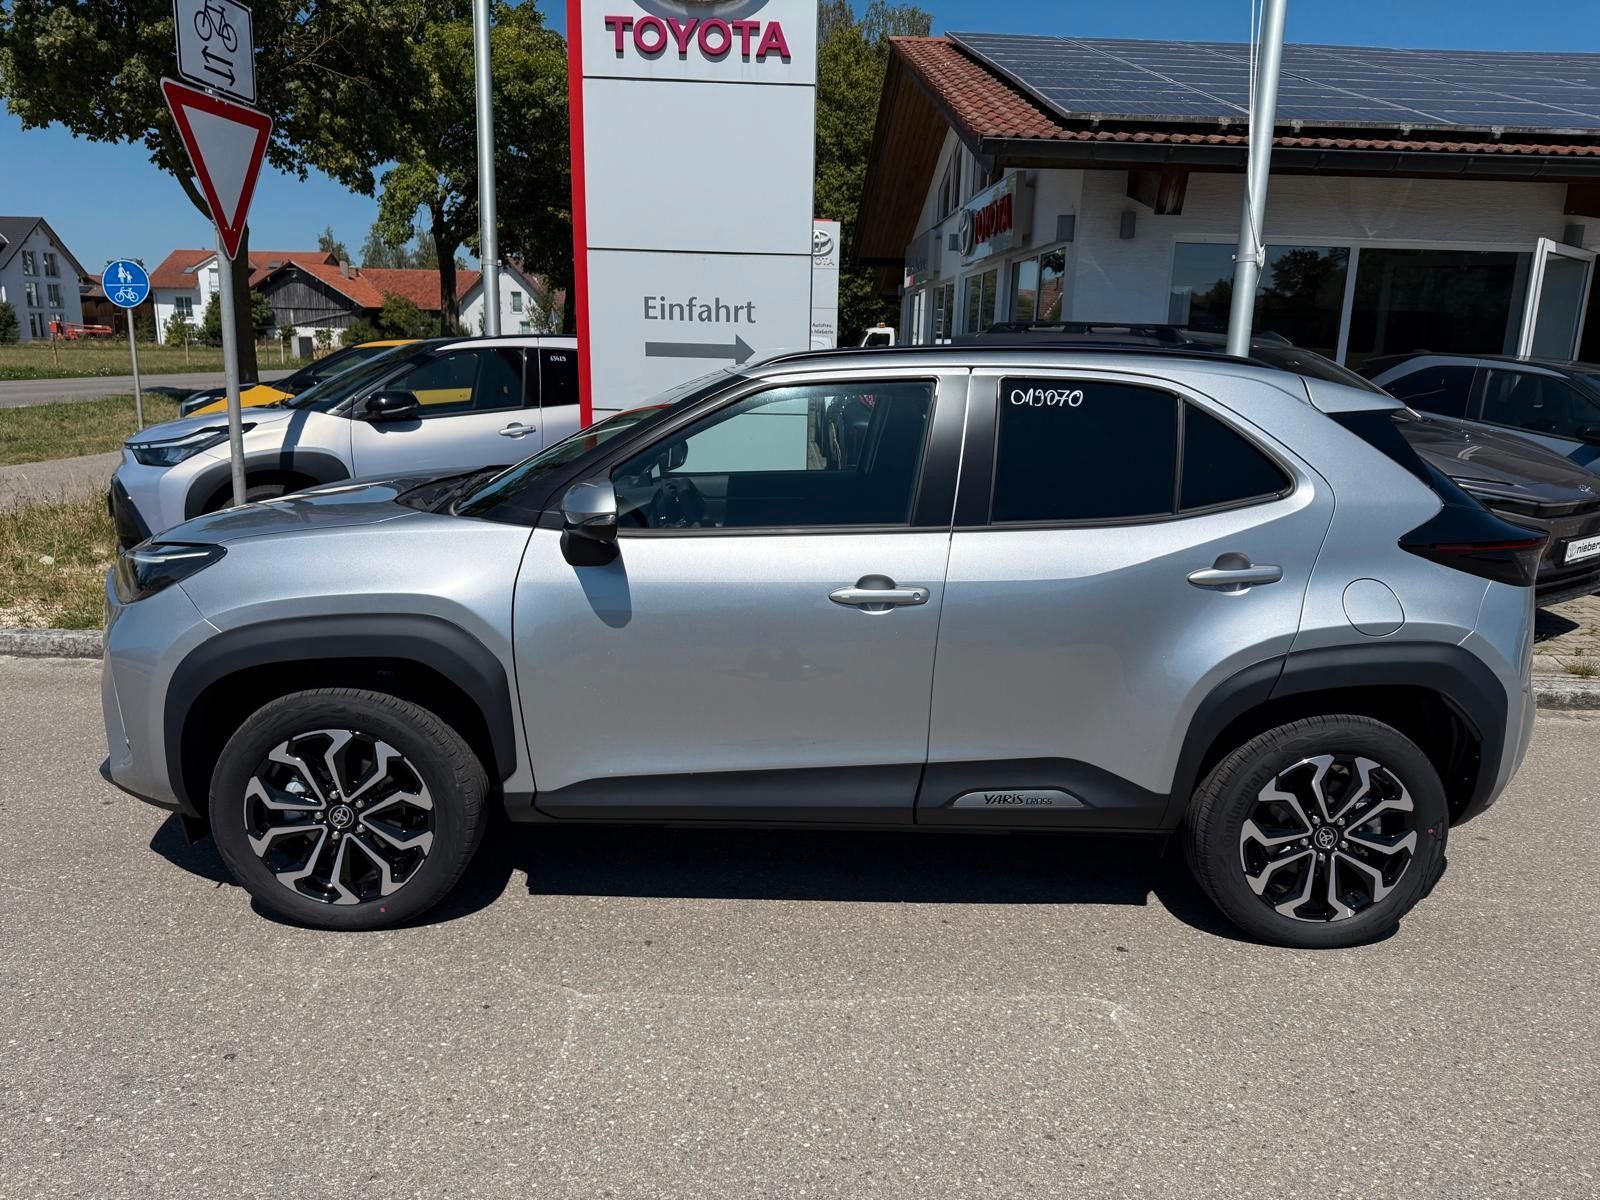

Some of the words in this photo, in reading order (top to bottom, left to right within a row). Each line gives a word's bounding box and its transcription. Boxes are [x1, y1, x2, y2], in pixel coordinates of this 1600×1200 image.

[605, 16, 791, 58] TOYOTA
[974, 193, 1012, 244] TOYOTA
[643, 296, 756, 323] Einfahrt
[1010, 388, 1084, 407] 019070
[1576, 541, 1600, 555] nieber
